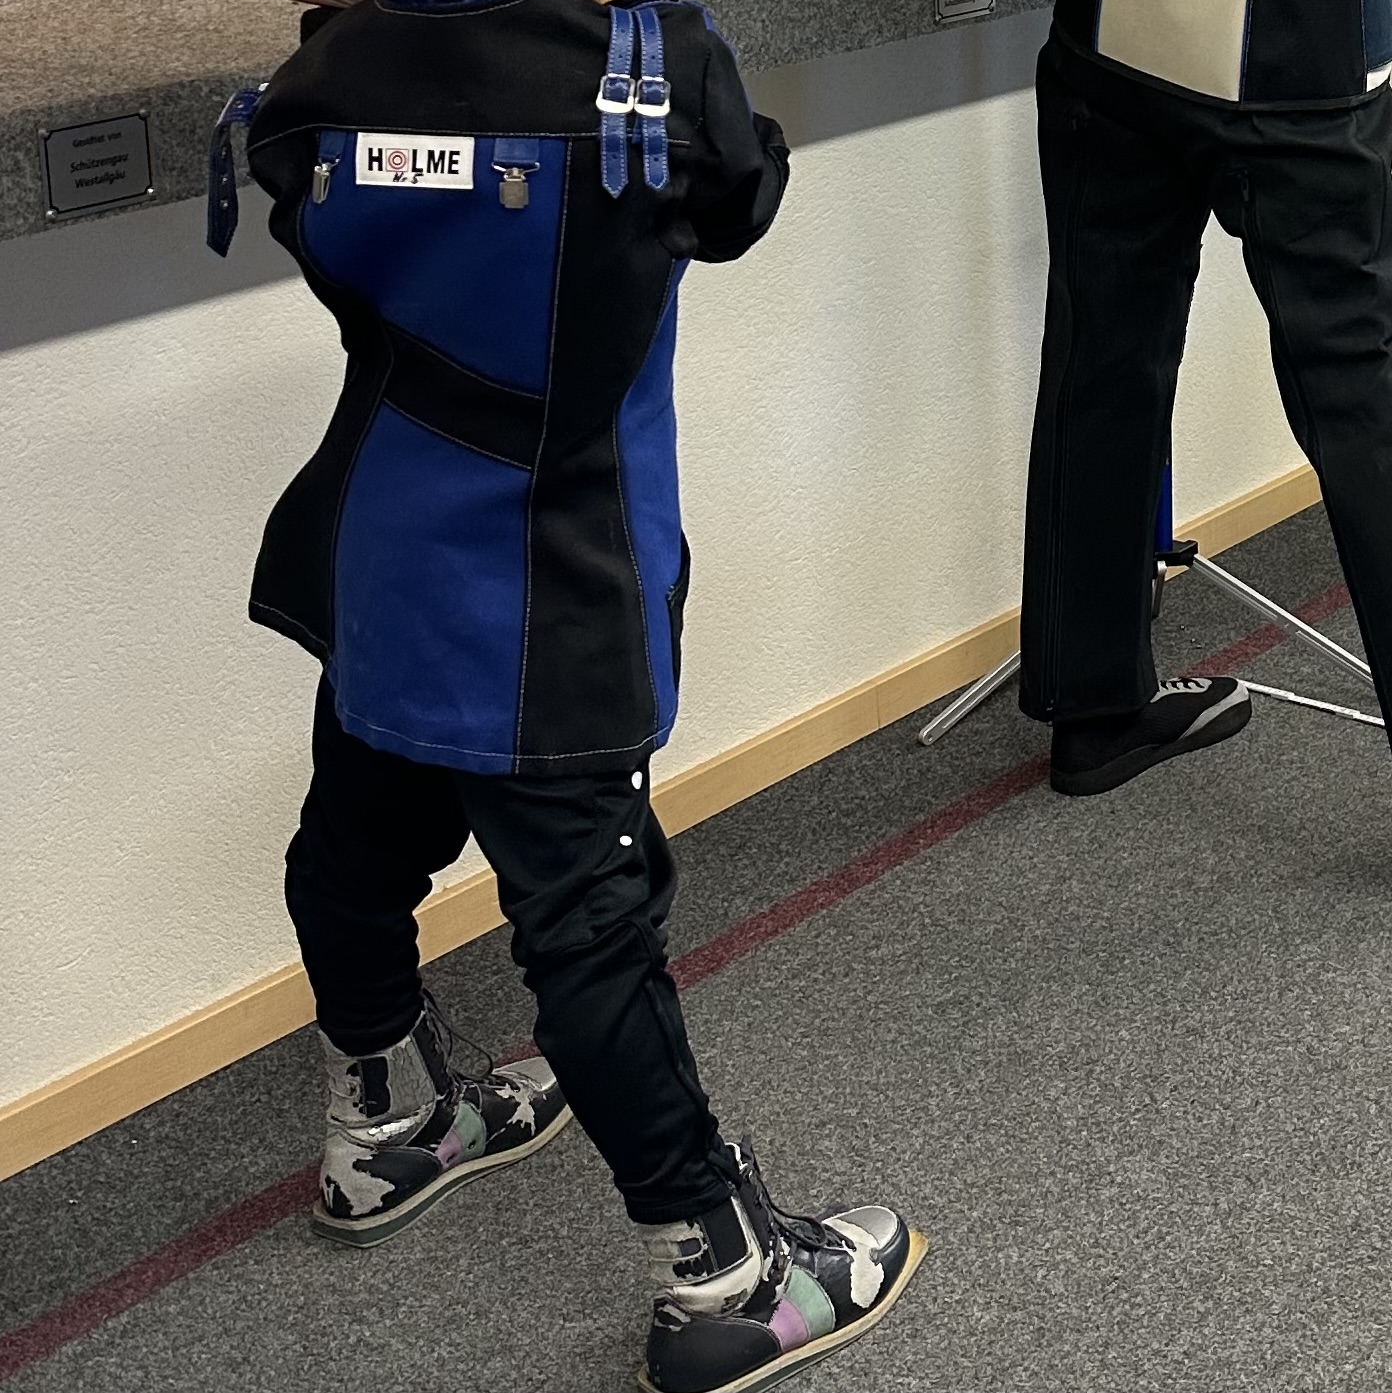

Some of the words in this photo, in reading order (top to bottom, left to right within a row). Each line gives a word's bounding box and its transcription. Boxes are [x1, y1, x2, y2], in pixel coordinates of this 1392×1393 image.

[70, 153, 129, 173] Schützengau
[368, 147, 461, 175] HOLME
[75, 169, 126, 188] Westallgäu
